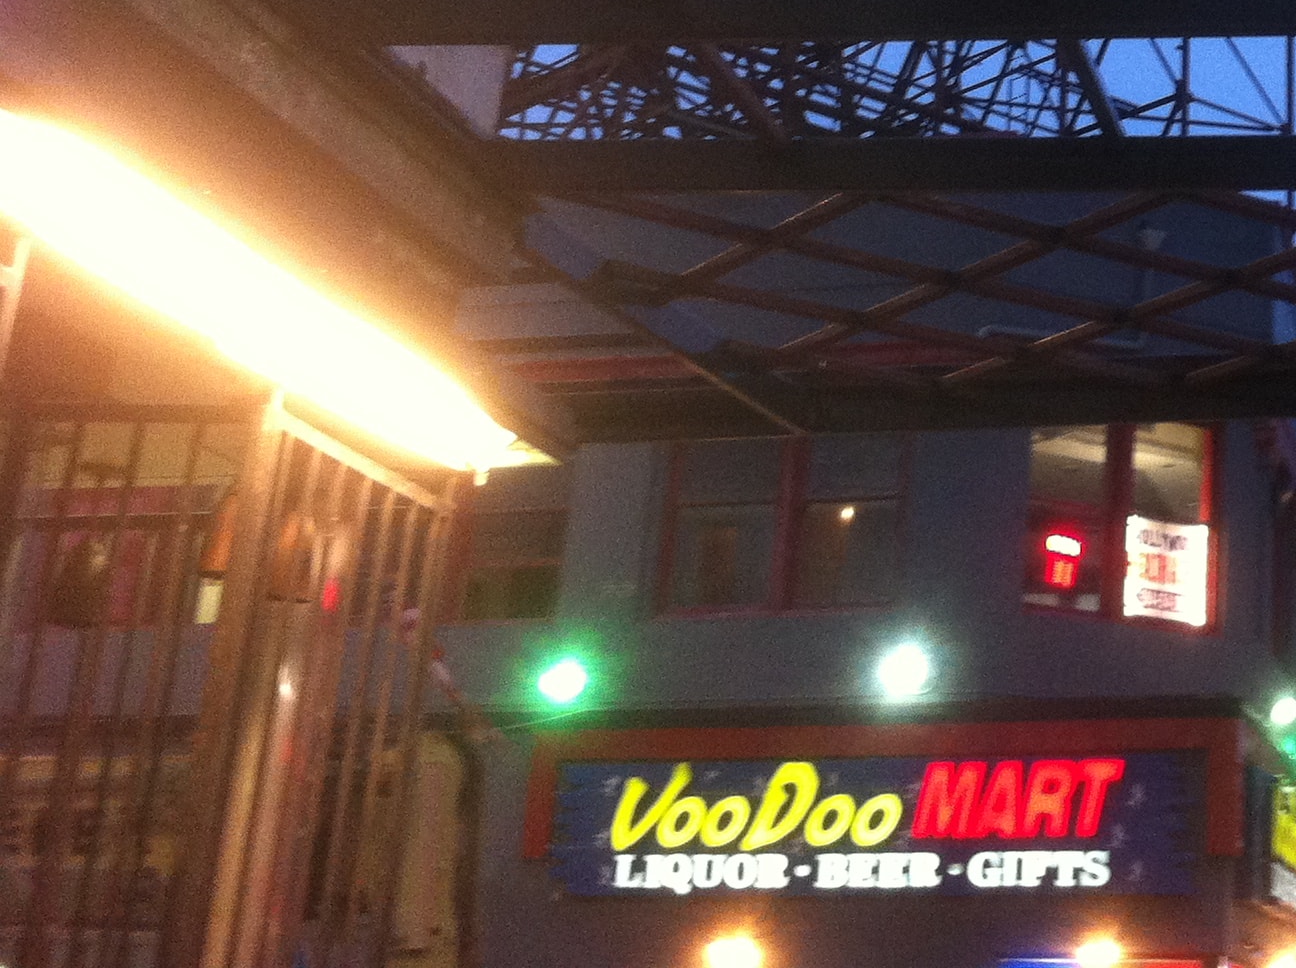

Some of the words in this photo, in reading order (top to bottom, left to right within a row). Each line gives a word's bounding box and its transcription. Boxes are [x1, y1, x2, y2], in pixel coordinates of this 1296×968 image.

[912, 759, 1125, 839] MART
[613, 852, 788, 894] LIQUOR
[815, 852, 941, 889] BEER
[966, 850, 1111, 888] GIFTS
